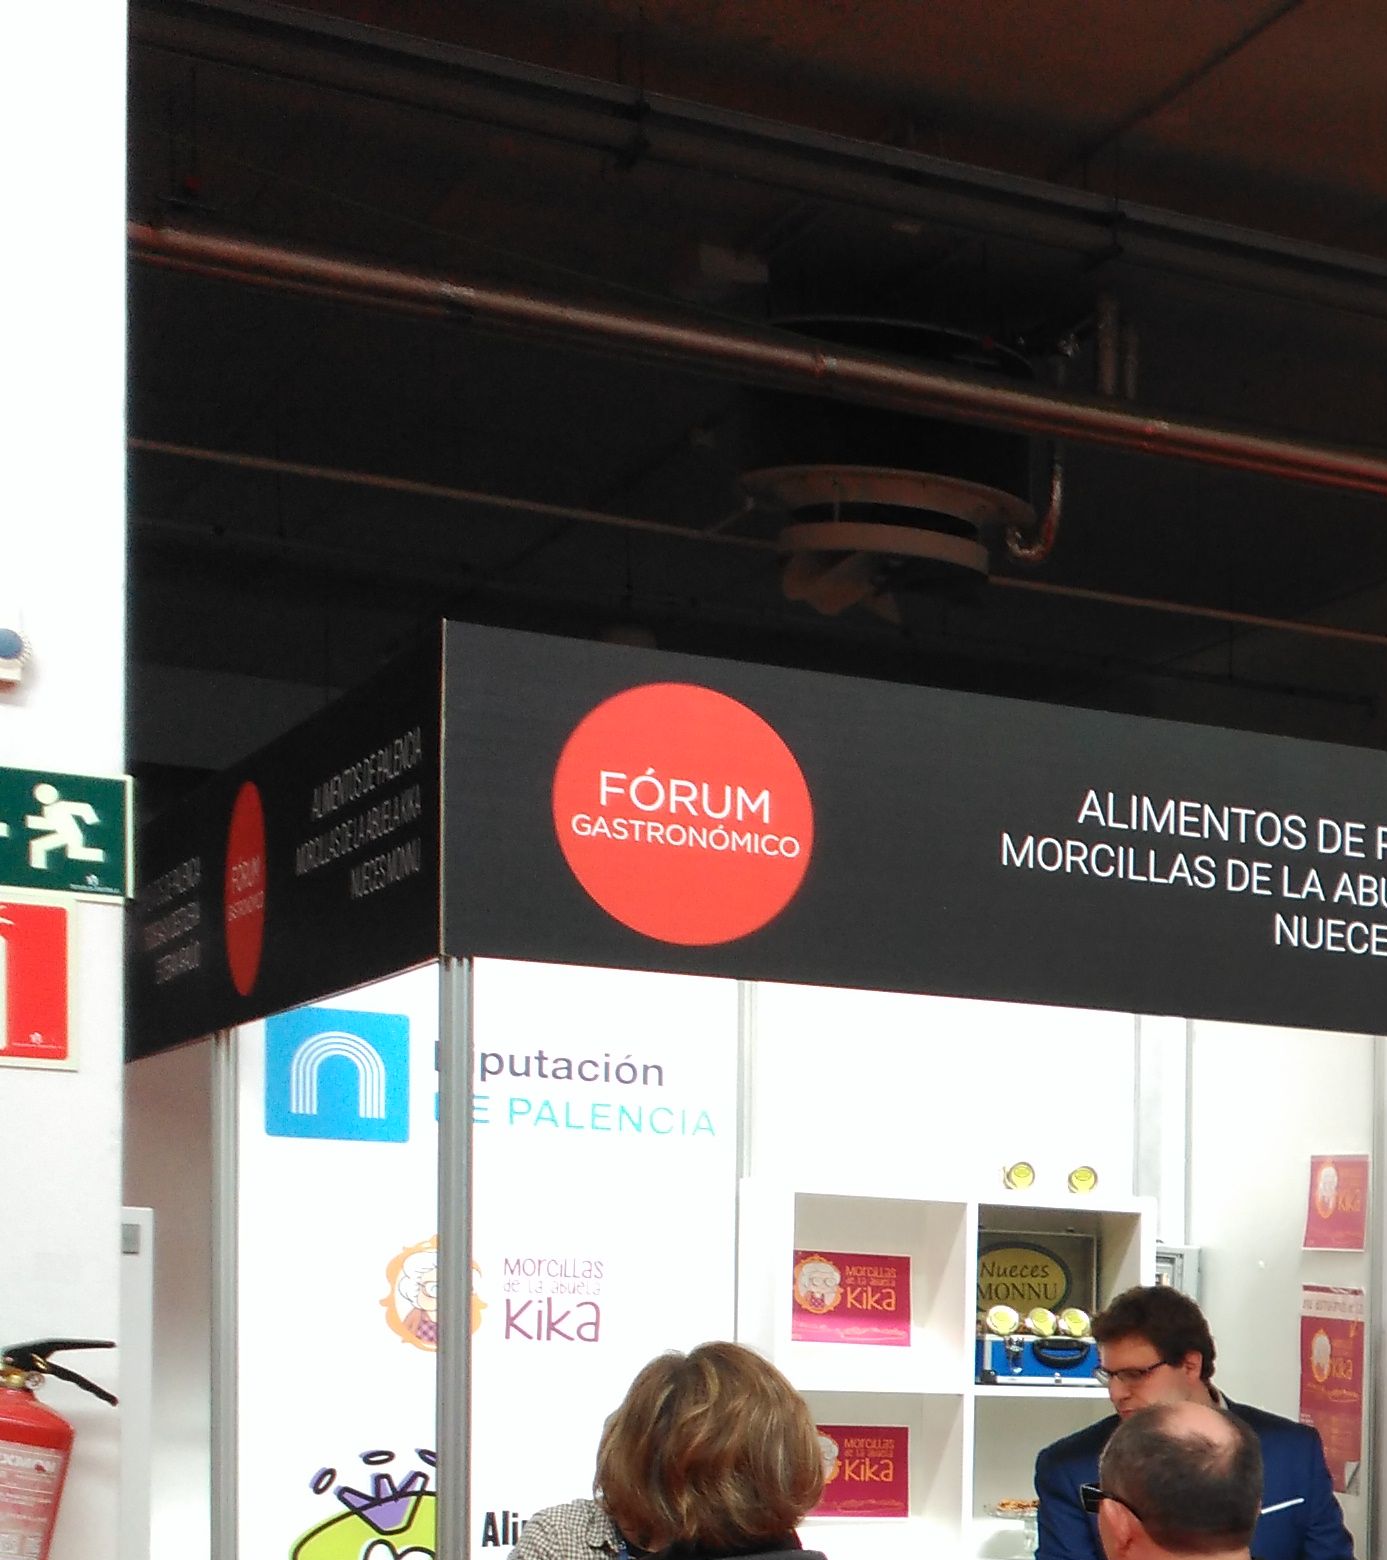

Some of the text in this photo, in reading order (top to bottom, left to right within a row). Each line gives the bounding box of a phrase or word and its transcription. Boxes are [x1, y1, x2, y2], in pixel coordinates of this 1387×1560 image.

[599, 767, 771, 825] FÓRUM
[571, 814, 801, 859] GASTRONÓMICO
[1077, 788, 1307, 850] ALIMENTOS
[1317, 820, 1365, 858] DE
[1001, 832, 1215, 889] MORCILLAS
[1226, 858, 1270, 895] DE
[1281, 865, 1326, 902] LA
[435, 1039, 664, 1087] putación
[508, 1097, 716, 1137] PALENCIA
[981, 1261, 1049, 1279] Nueces
